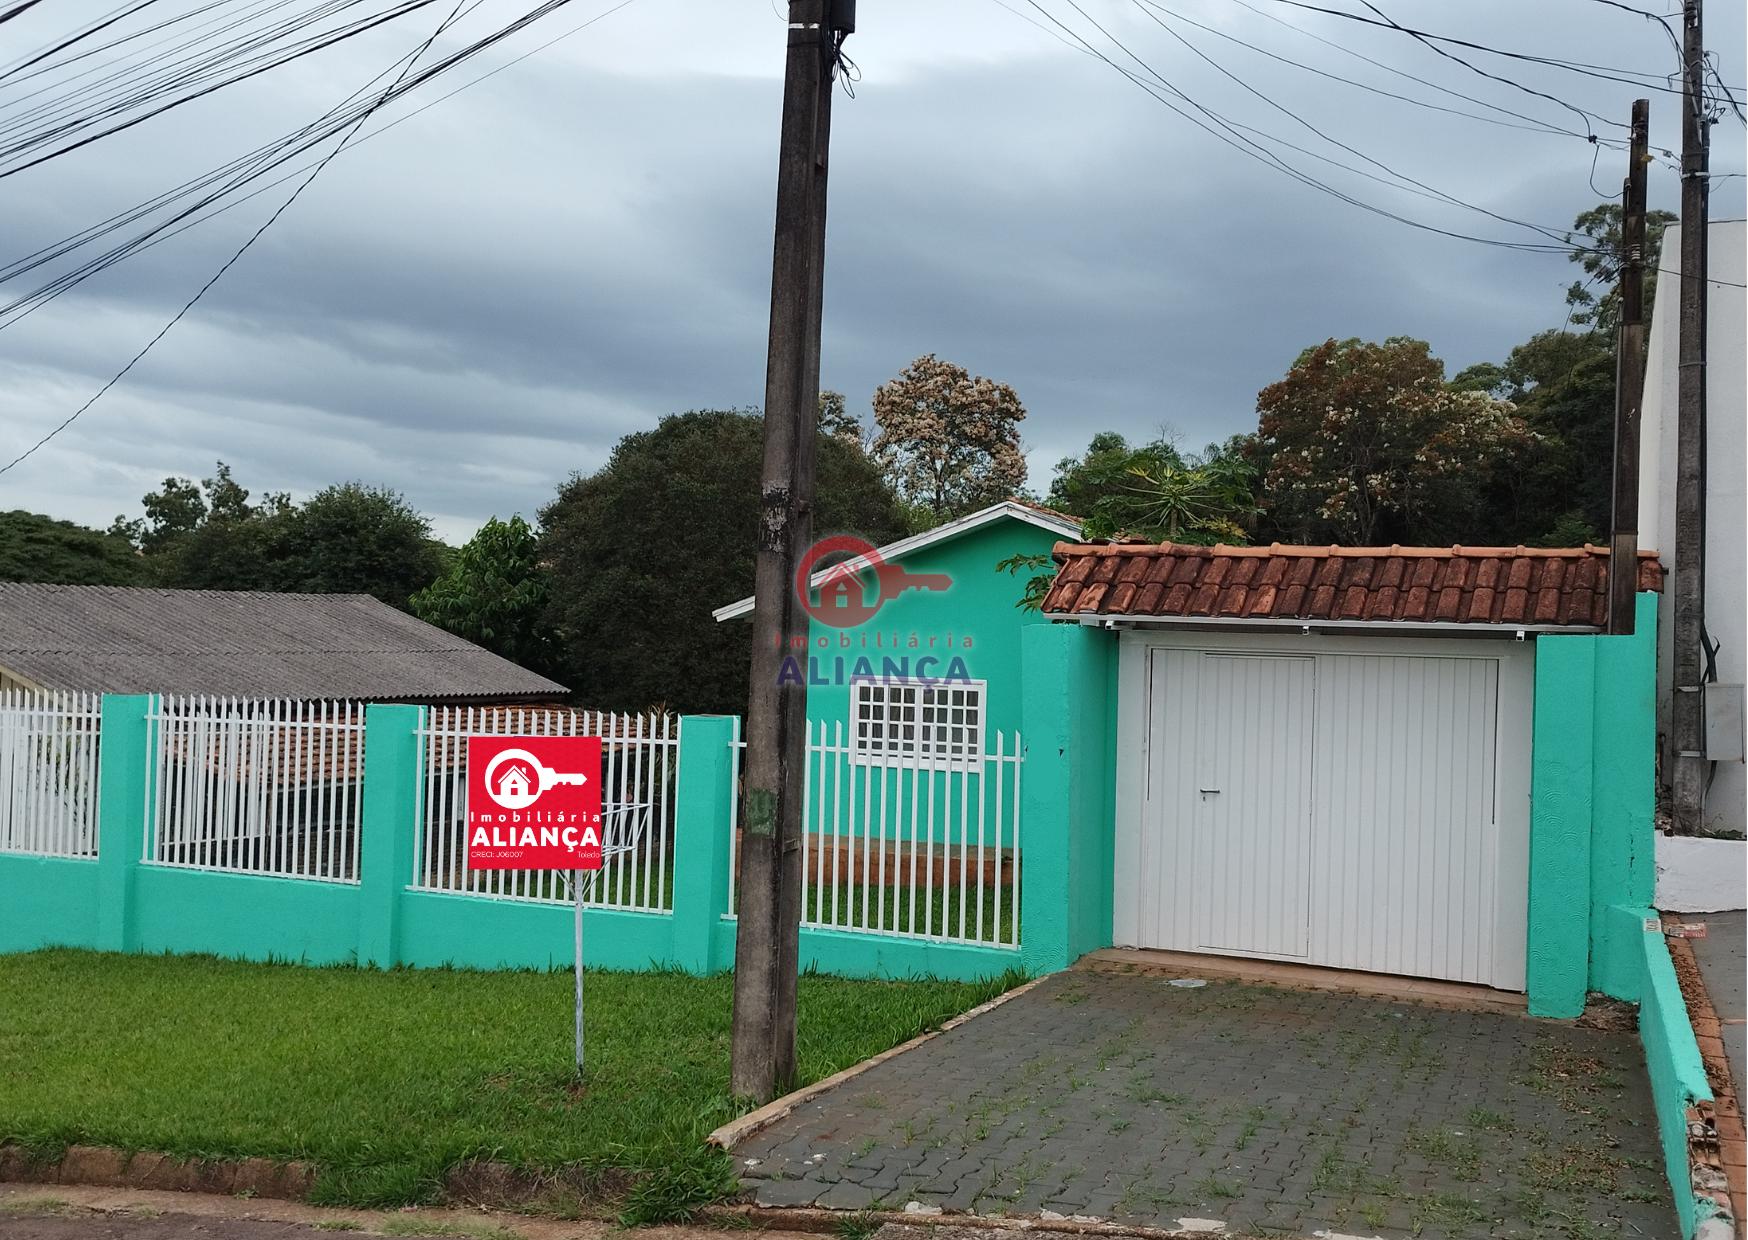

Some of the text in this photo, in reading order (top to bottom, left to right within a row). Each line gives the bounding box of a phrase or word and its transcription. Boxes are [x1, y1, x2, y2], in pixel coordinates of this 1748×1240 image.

[470, 811, 600, 823] Imobiliária
[471, 827, 600, 853] ALIANÇA
[577, 850, 600, 859] Toledo
